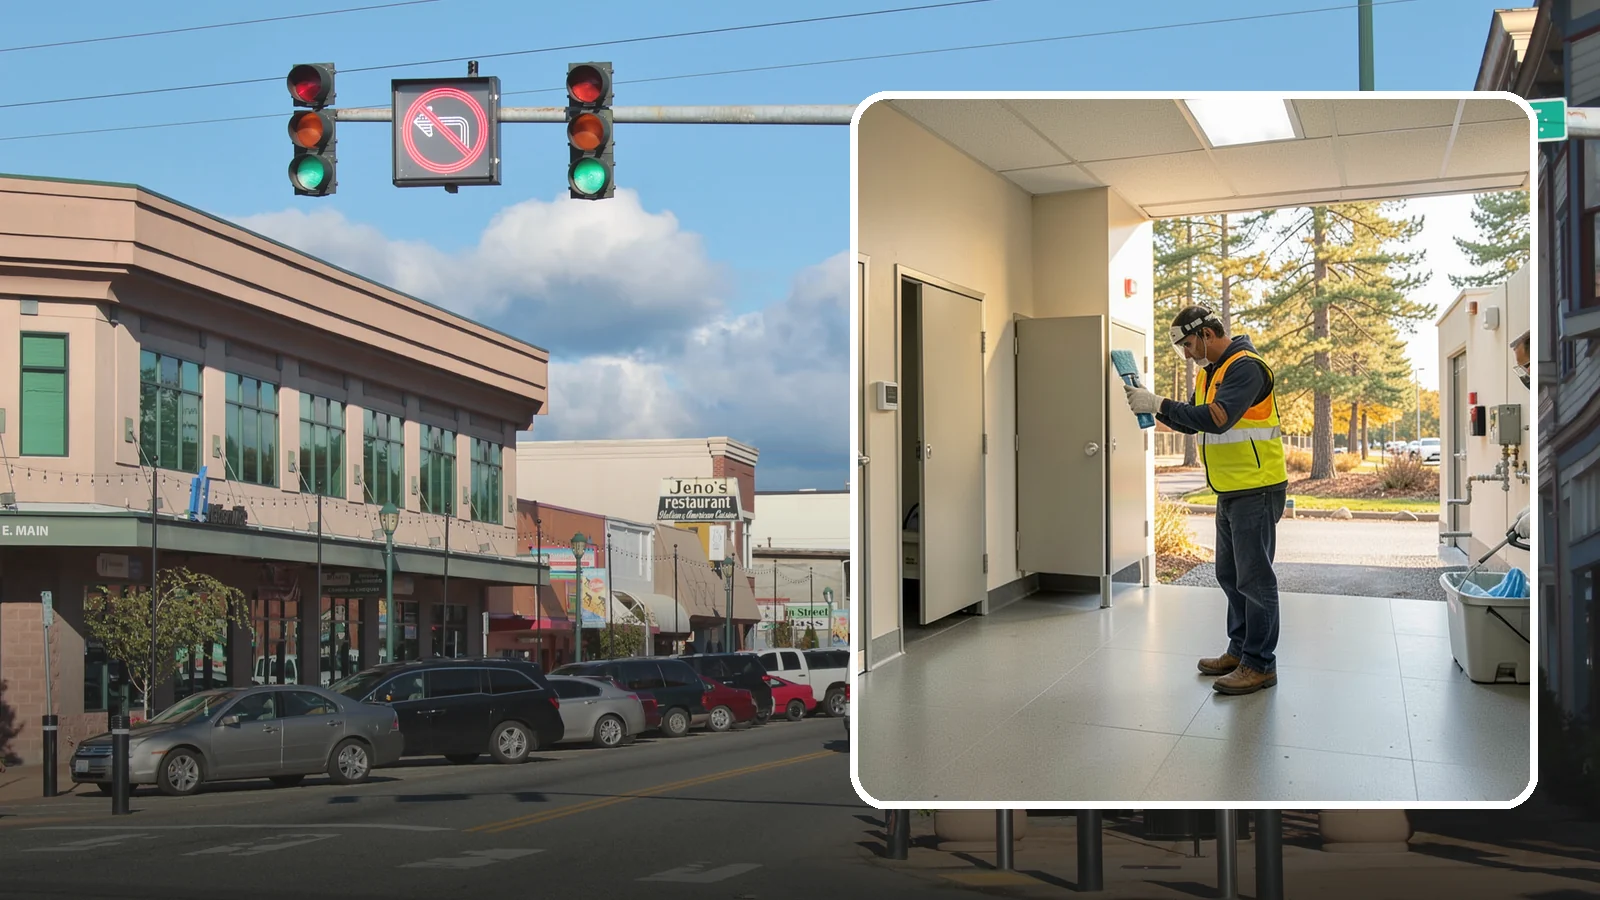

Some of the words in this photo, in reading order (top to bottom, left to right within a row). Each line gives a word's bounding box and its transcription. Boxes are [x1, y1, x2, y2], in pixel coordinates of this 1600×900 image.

[669, 480, 727, 494] Jeno's
[665, 497, 731, 508] restaurant
[659, 510, 681, 519] Italian
[686, 510, 714, 519] American
[715, 509, 738, 519] Cuisine
[2, 525, 13, 536] E.
[15, 525, 49, 536] MAIN
[797, 608, 828, 617] Street
